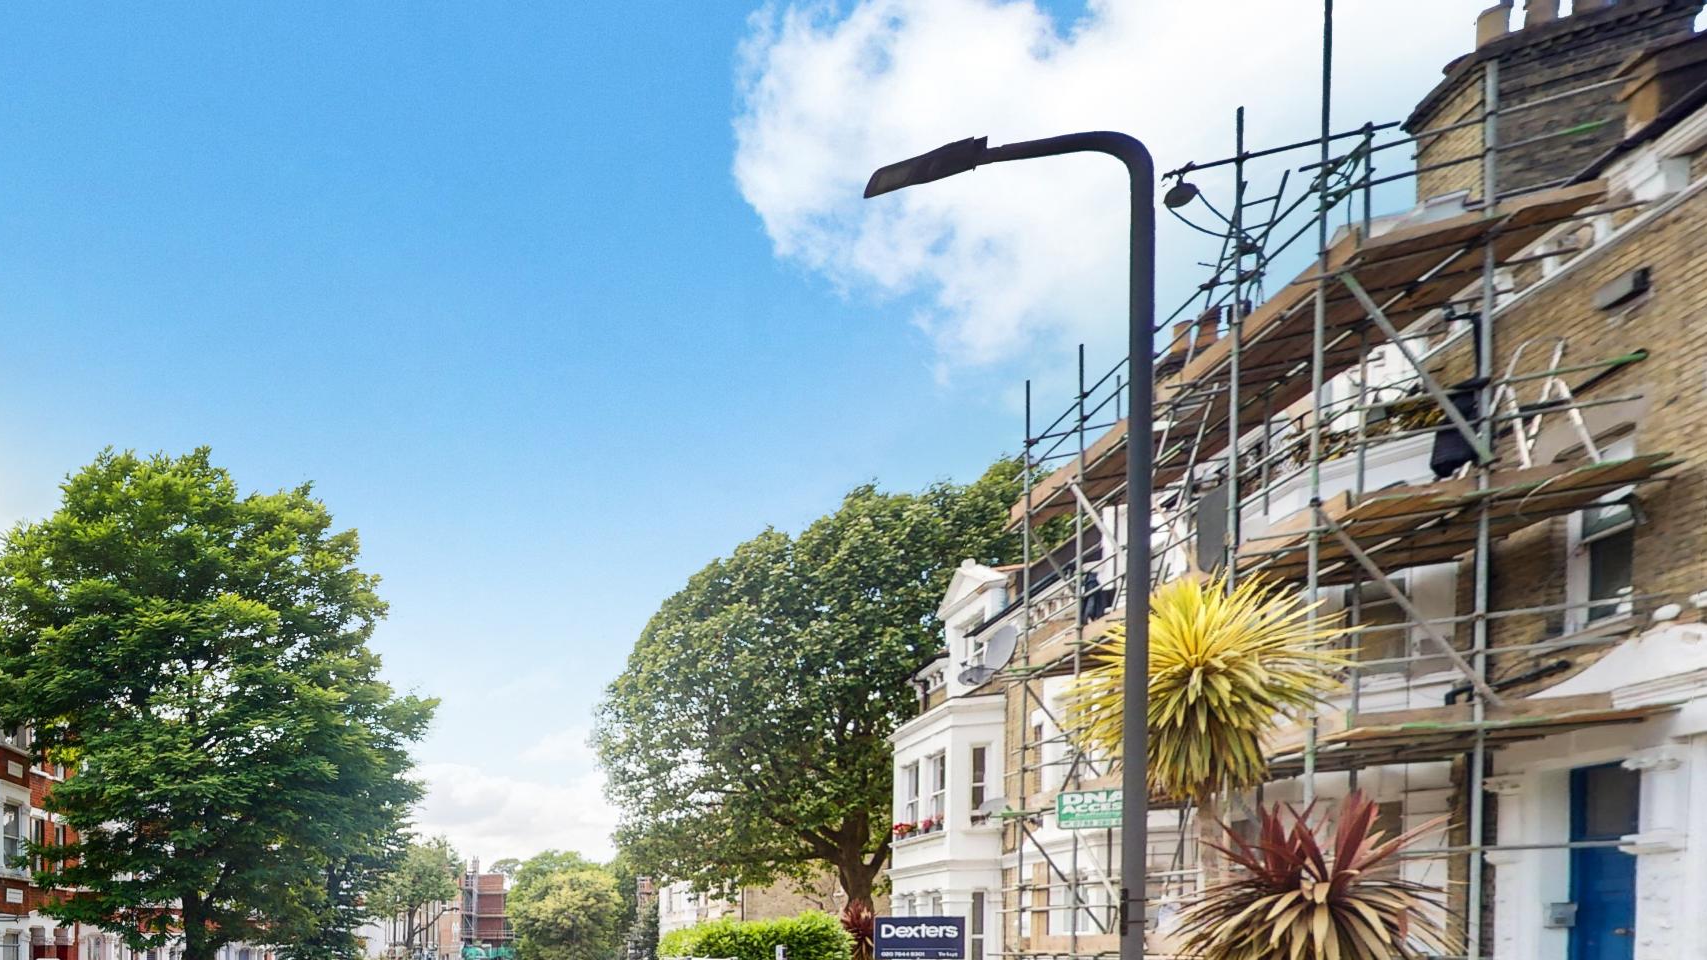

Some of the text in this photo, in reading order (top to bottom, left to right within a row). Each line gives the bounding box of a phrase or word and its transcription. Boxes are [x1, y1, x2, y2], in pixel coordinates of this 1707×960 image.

[1063, 790, 1122, 806] DNA
[1062, 802, 1122, 814] ACCES
[880, 923, 958, 939] Dexters
